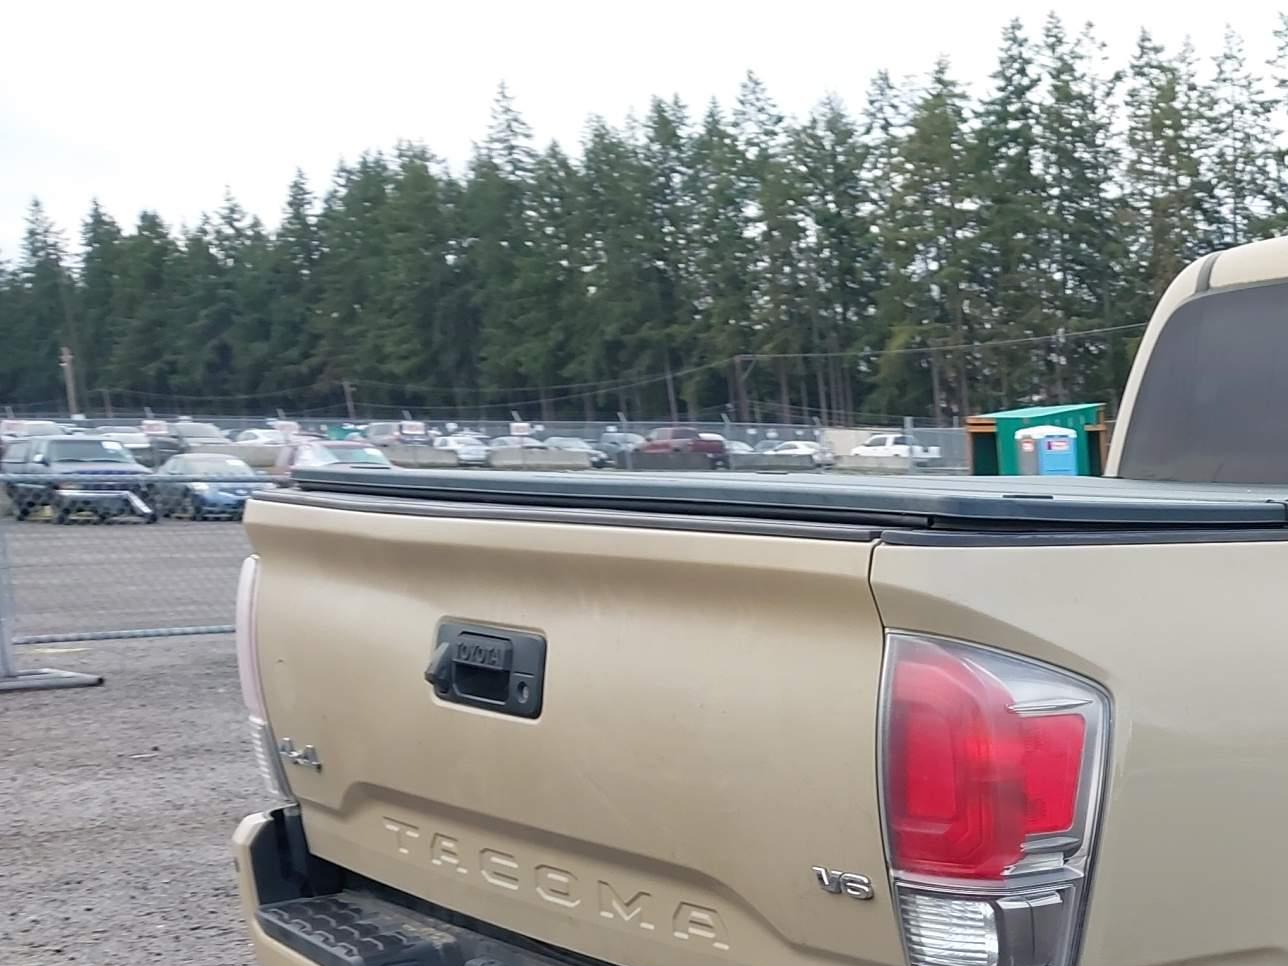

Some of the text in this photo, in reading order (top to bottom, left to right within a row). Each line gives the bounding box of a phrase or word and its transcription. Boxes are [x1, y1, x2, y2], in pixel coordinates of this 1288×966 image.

[455, 641, 504, 667] TOYOTA
[382, 815, 731, 951] TACOMA
[811, 865, 874, 900] V6
